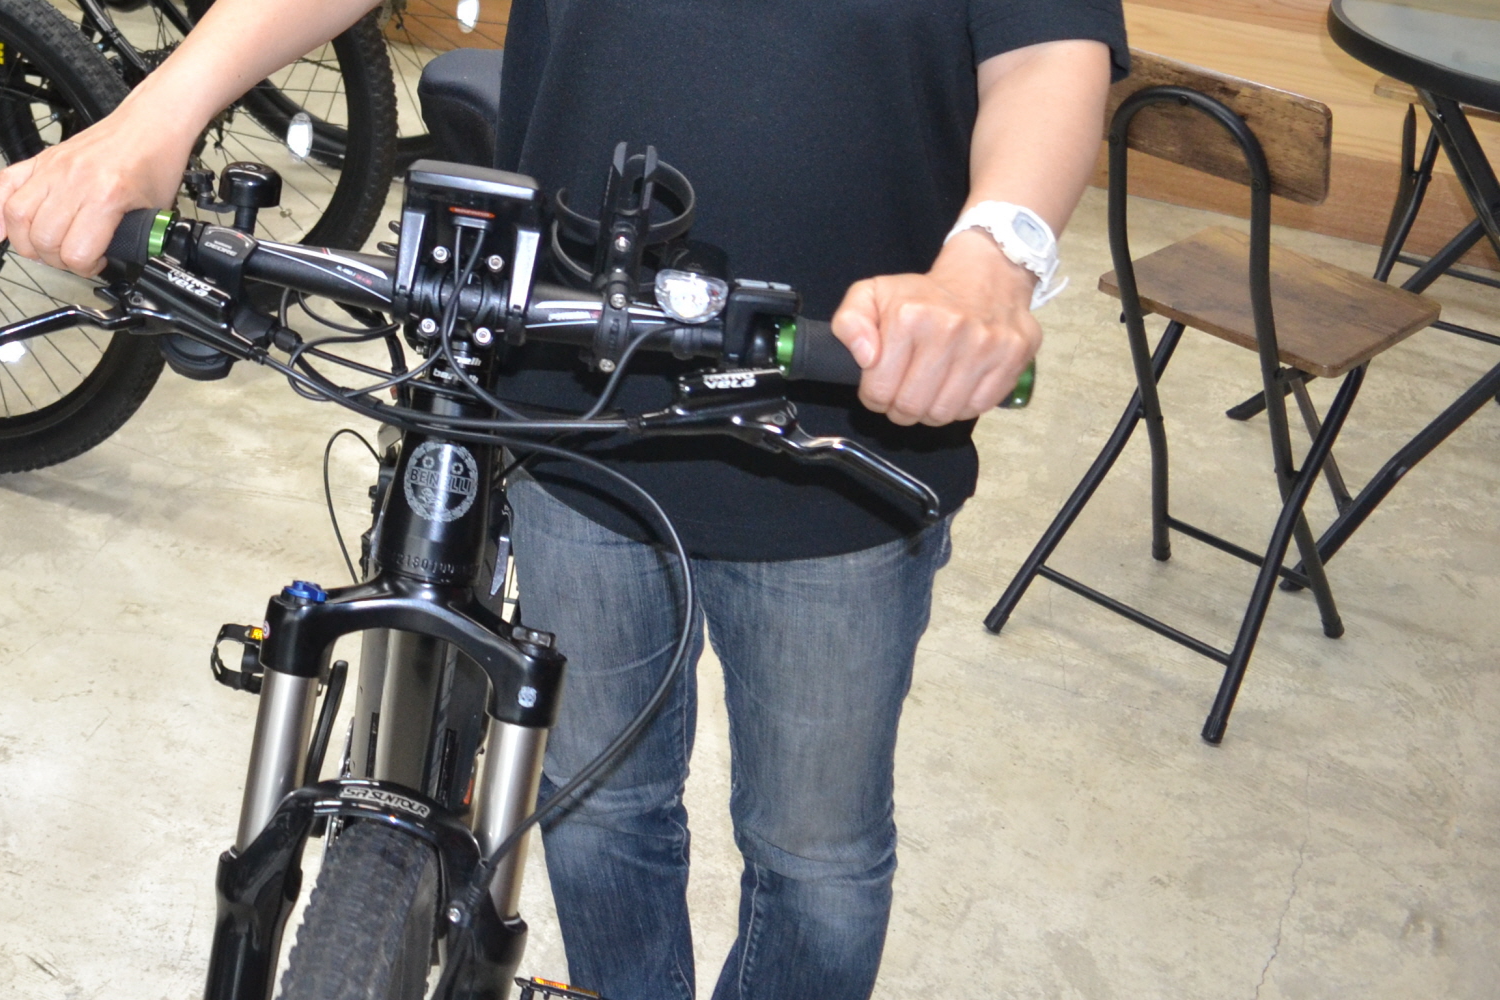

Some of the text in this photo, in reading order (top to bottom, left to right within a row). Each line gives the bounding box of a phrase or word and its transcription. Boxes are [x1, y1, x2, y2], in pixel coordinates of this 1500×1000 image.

[204, 241, 238, 257] DEORE
[409, 468, 473, 496] BENLLI
[341, 787, 430, 818] SR SUNTOUR
